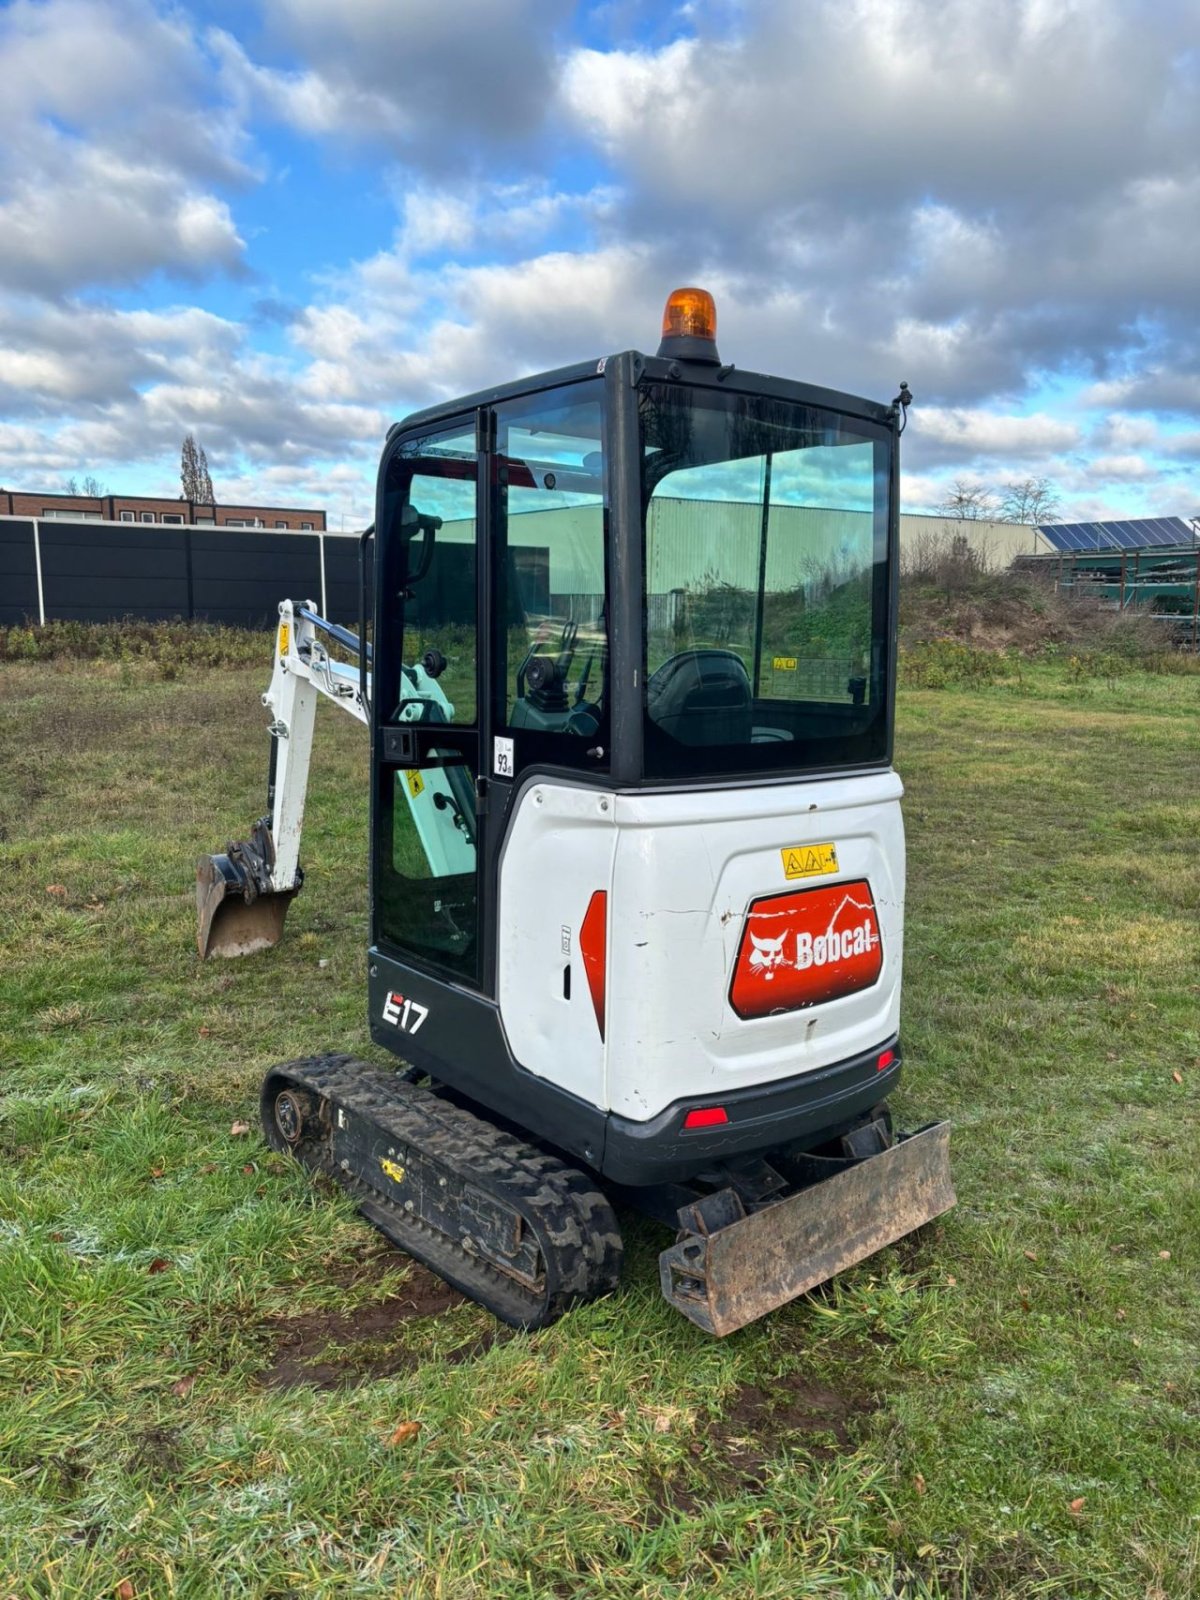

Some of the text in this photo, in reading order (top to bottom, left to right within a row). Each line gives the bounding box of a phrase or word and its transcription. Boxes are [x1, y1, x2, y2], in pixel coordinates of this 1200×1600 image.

[498, 753, 507, 773] 93
[796, 919, 871, 970] Bobcat
[382, 991, 429, 1034] E17
